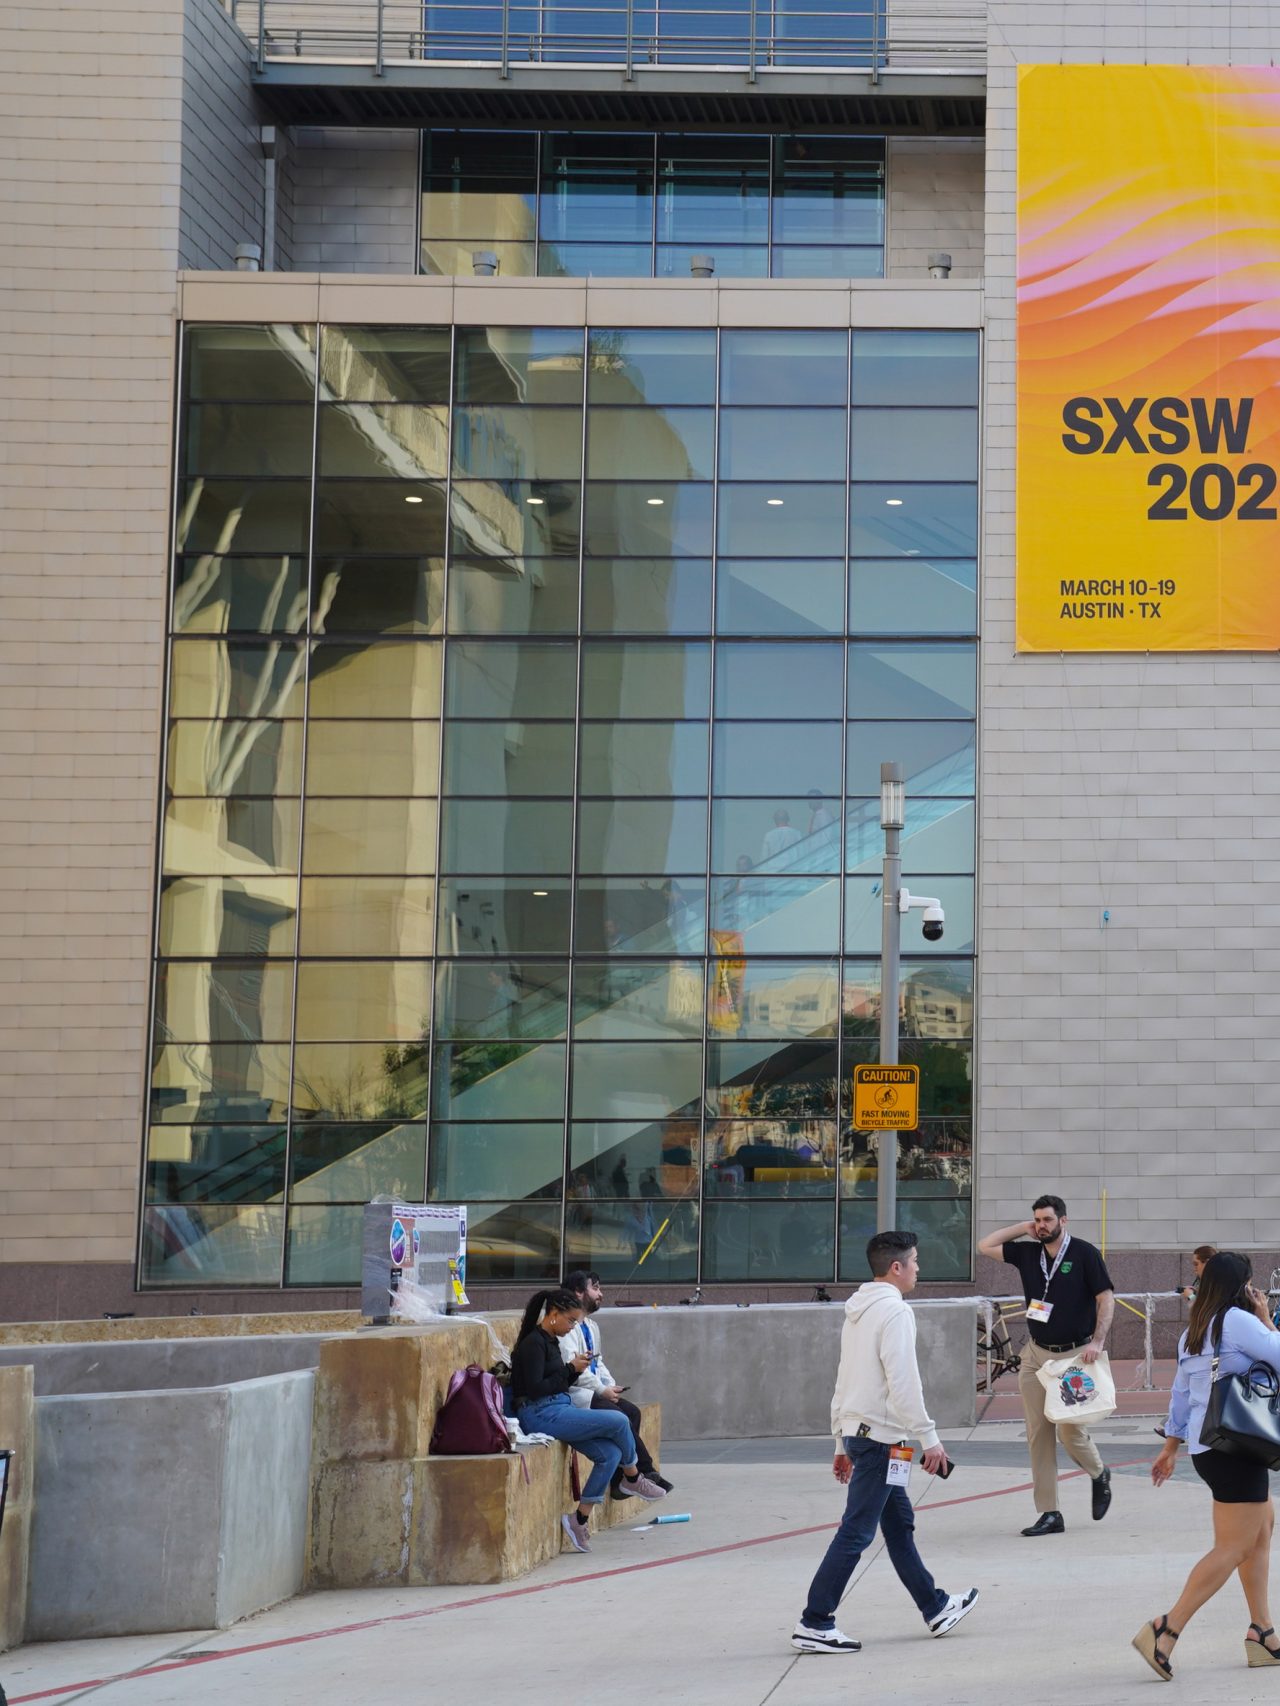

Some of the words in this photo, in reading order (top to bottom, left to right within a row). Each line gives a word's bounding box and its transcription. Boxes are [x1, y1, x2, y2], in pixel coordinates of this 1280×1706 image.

[1062, 397, 1254, 455] SXSW
[1060, 579, 1125, 596] MARCH
[1060, 602, 1125, 619] AUSTIN
[1140, 602, 1162, 618] TX
[862, 1071, 911, 1082] CAUTION!
[861, 1110, 880, 1118] FAST
[882, 1110, 910, 1118] MOVING
